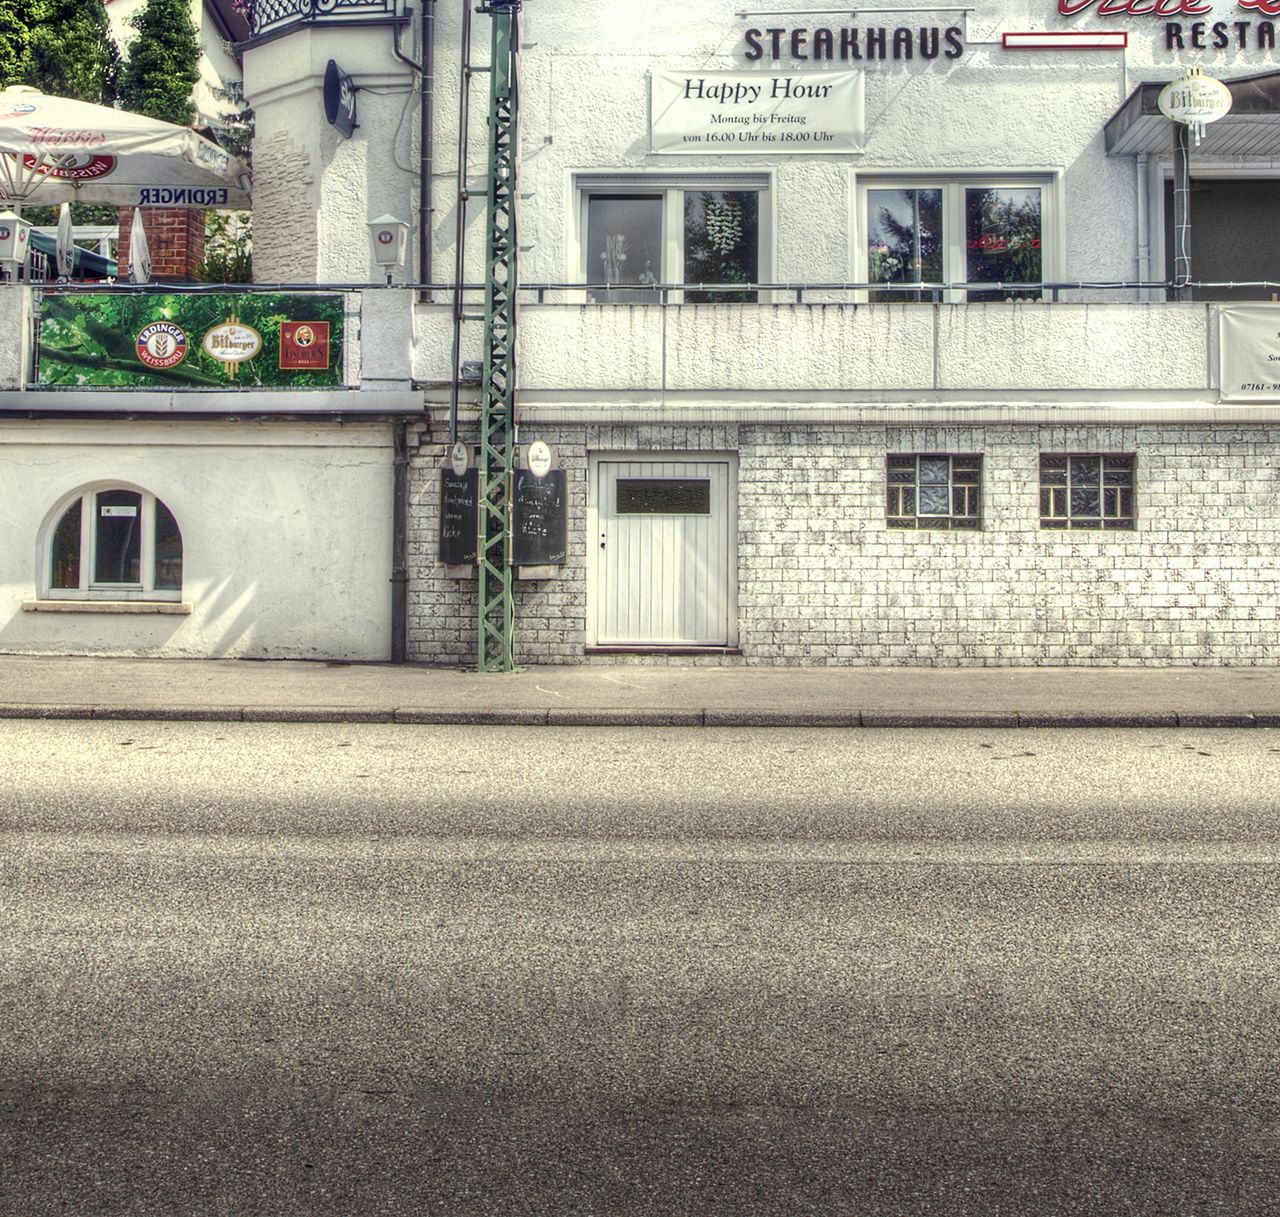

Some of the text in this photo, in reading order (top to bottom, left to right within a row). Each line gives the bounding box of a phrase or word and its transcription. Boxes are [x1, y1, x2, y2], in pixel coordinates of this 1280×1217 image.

[744, 27, 963, 60] STEAKHAUS
[683, 78, 833, 104] Happy Hour
[710, 114, 807, 125] Montag bis Freitag
[683, 132, 835, 142] von 16.00 Uhr bis 18.00 Uhr
[140, 324, 184, 342] ERDINGER
[211, 335, 255, 350] Bitburger
